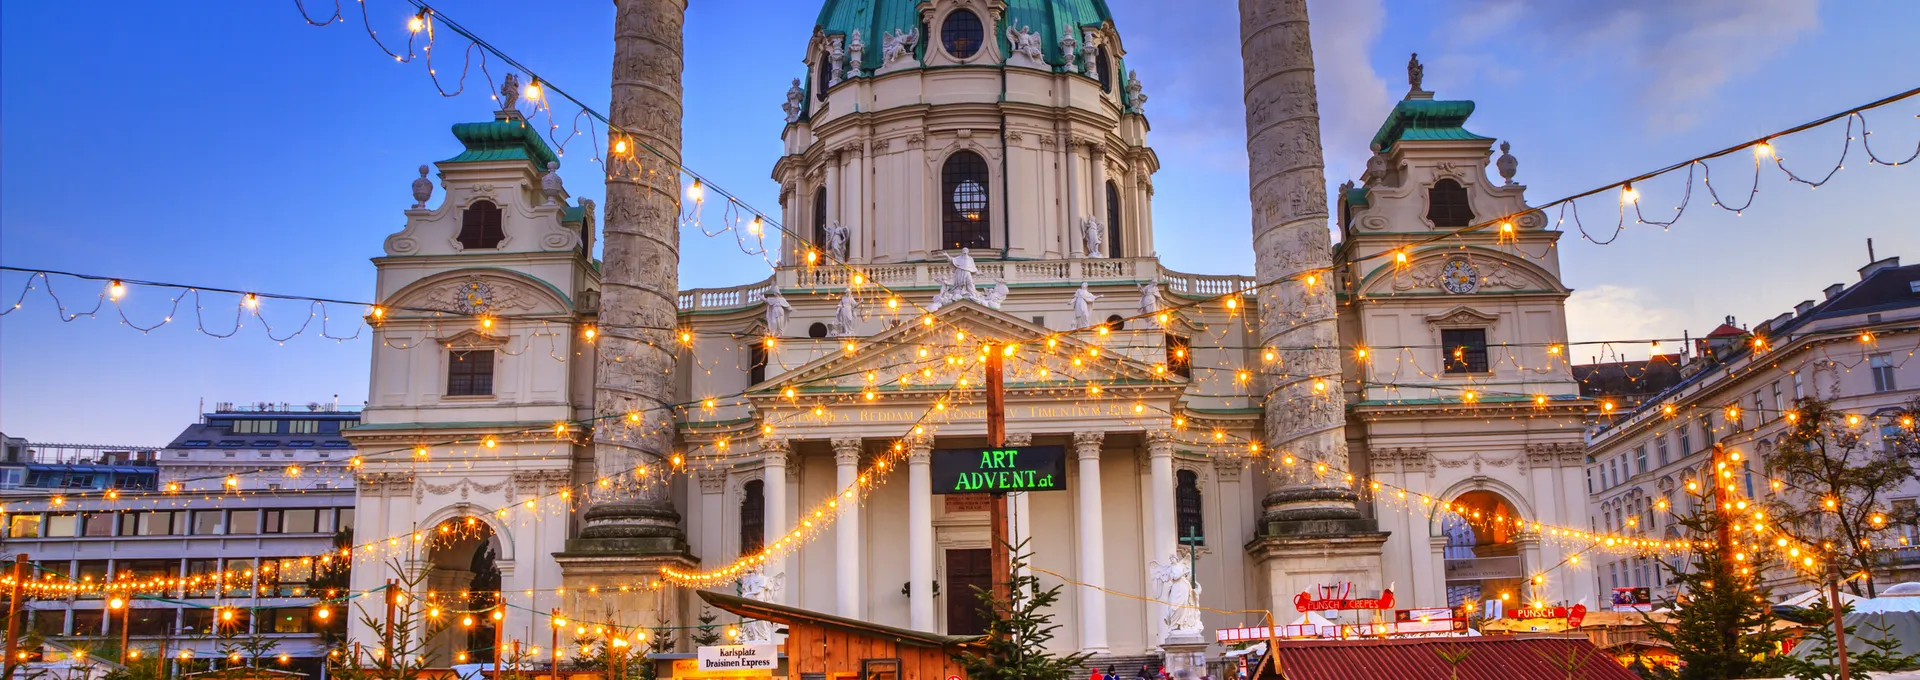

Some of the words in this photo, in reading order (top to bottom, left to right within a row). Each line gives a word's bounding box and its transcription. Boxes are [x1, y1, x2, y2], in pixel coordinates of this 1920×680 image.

[860, 409, 914, 422] REDDAM
[980, 450, 1018, 469] ART
[954, 470, 1054, 491] ADVENT.at
[1307, 600, 1340, 610] PUNSCH
[1517, 608, 1555, 618] PUNSCH
[720, 648, 756, 658] Karlsplatz
[705, 658, 740, 668] Draisinen
[741, 657, 770, 668] Express
